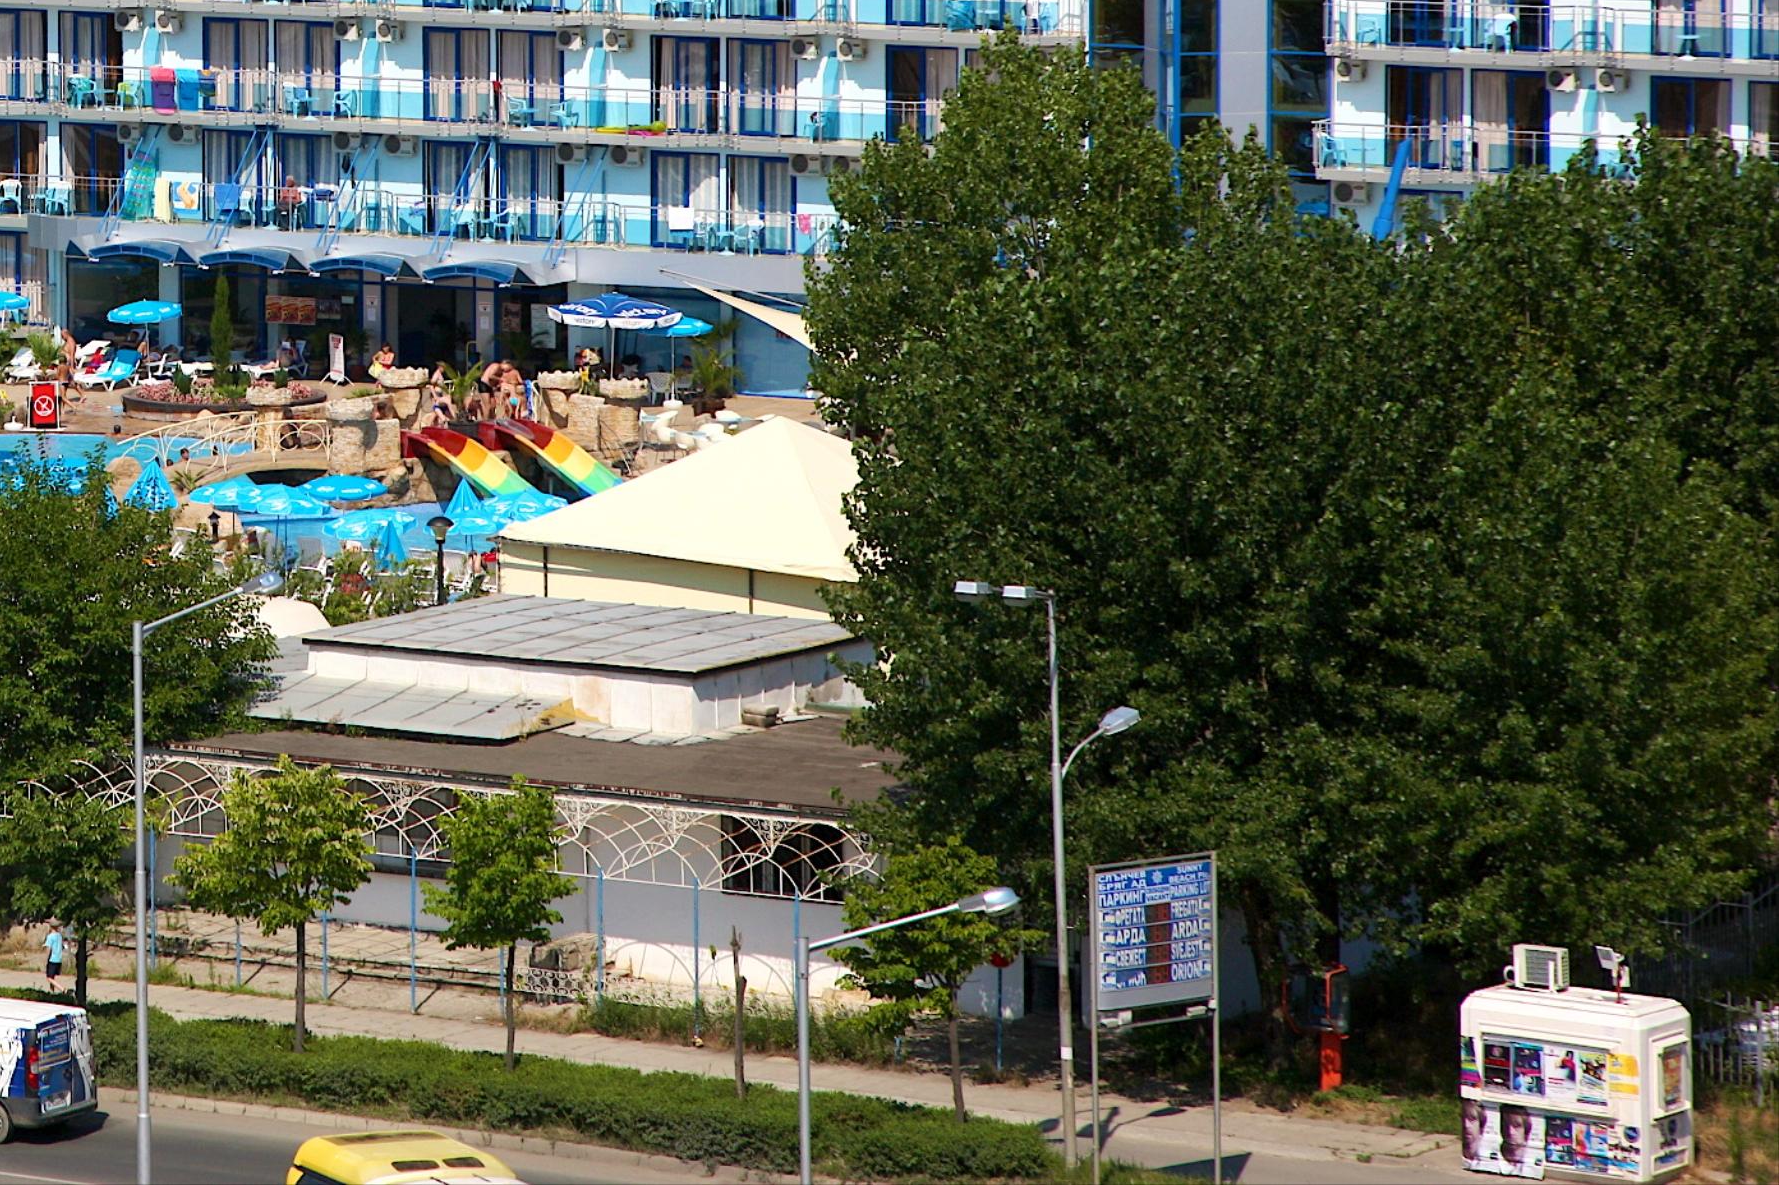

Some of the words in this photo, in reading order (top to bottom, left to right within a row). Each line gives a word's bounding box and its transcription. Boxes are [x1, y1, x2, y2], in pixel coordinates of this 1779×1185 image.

[1098, 870, 1146, 883] СЛЪНЧЕВ
[1177, 864, 1203, 874] SUNNY
[1099, 881, 1126, 891] БРЯГ
[1131, 879, 1147, 889] АД
[1170, 883, 1199, 898] PARKING
[1098, 890, 1146, 908] ПАРКИНГ
[1116, 928, 1146, 945] АРДА
[1172, 919, 1199, 939] ARDA
[1171, 961, 1200, 982] ORION
